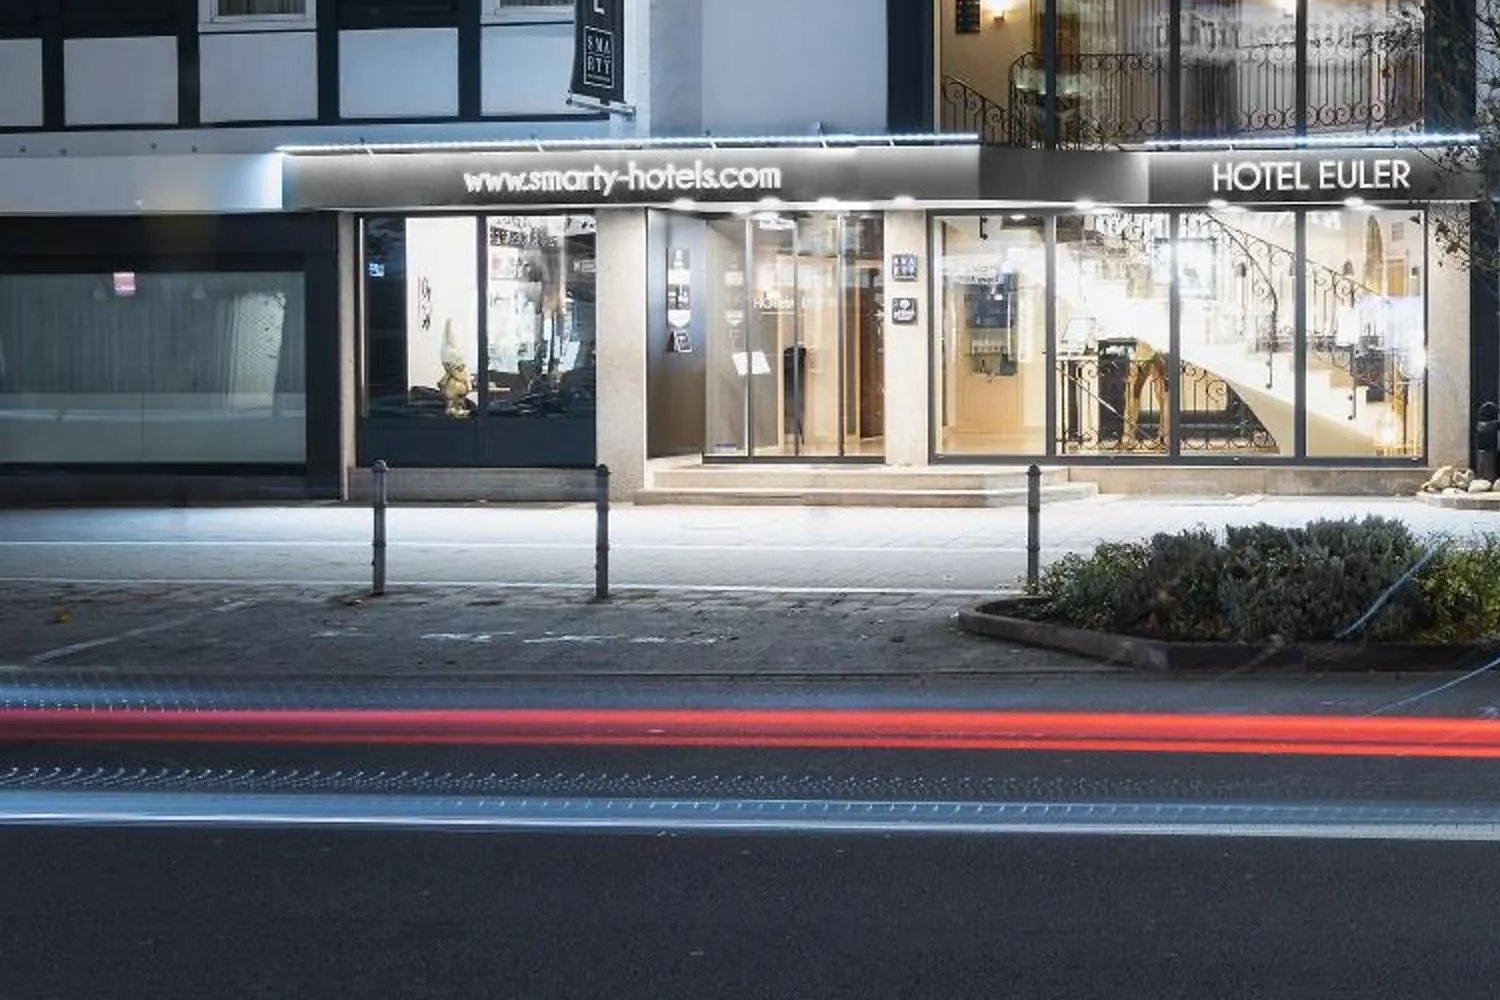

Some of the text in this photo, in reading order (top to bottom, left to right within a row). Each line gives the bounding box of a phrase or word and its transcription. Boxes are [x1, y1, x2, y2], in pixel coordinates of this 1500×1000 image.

[463, 160, 782, 196] www.smarty-hotels.com
[1213, 158, 1412, 192] HOTEL EULER
